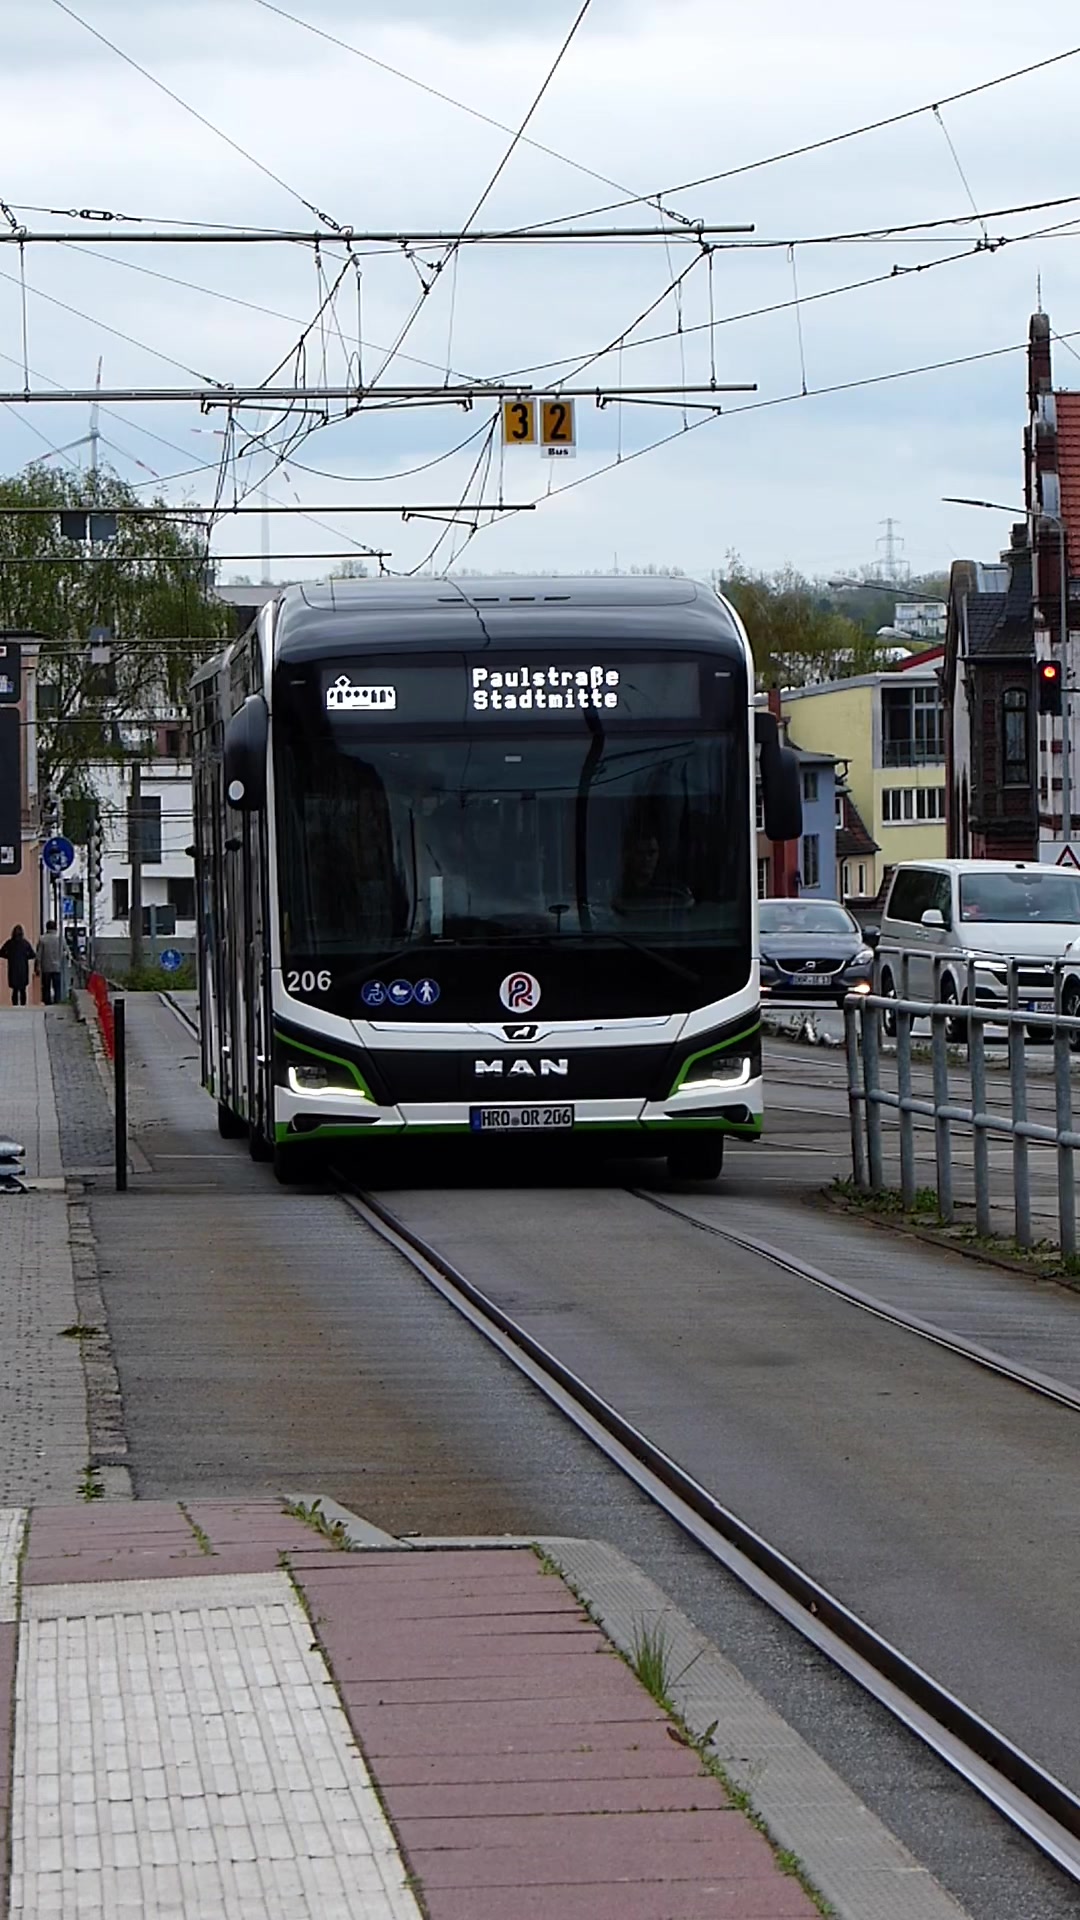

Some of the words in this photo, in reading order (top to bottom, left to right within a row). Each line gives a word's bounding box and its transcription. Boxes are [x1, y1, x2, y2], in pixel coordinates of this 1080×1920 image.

[511, 403, 528, 439] 3
[550, 404, 566, 439] 2
[548, 447, 569, 456] Bus
[472, 665, 619, 689] Paulstraße
[473, 688, 617, 710] Stadtmitte
[287, 970, 332, 991] 206
[475, 1059, 568, 1076] MAN
[543, 1108, 571, 1125] 206
